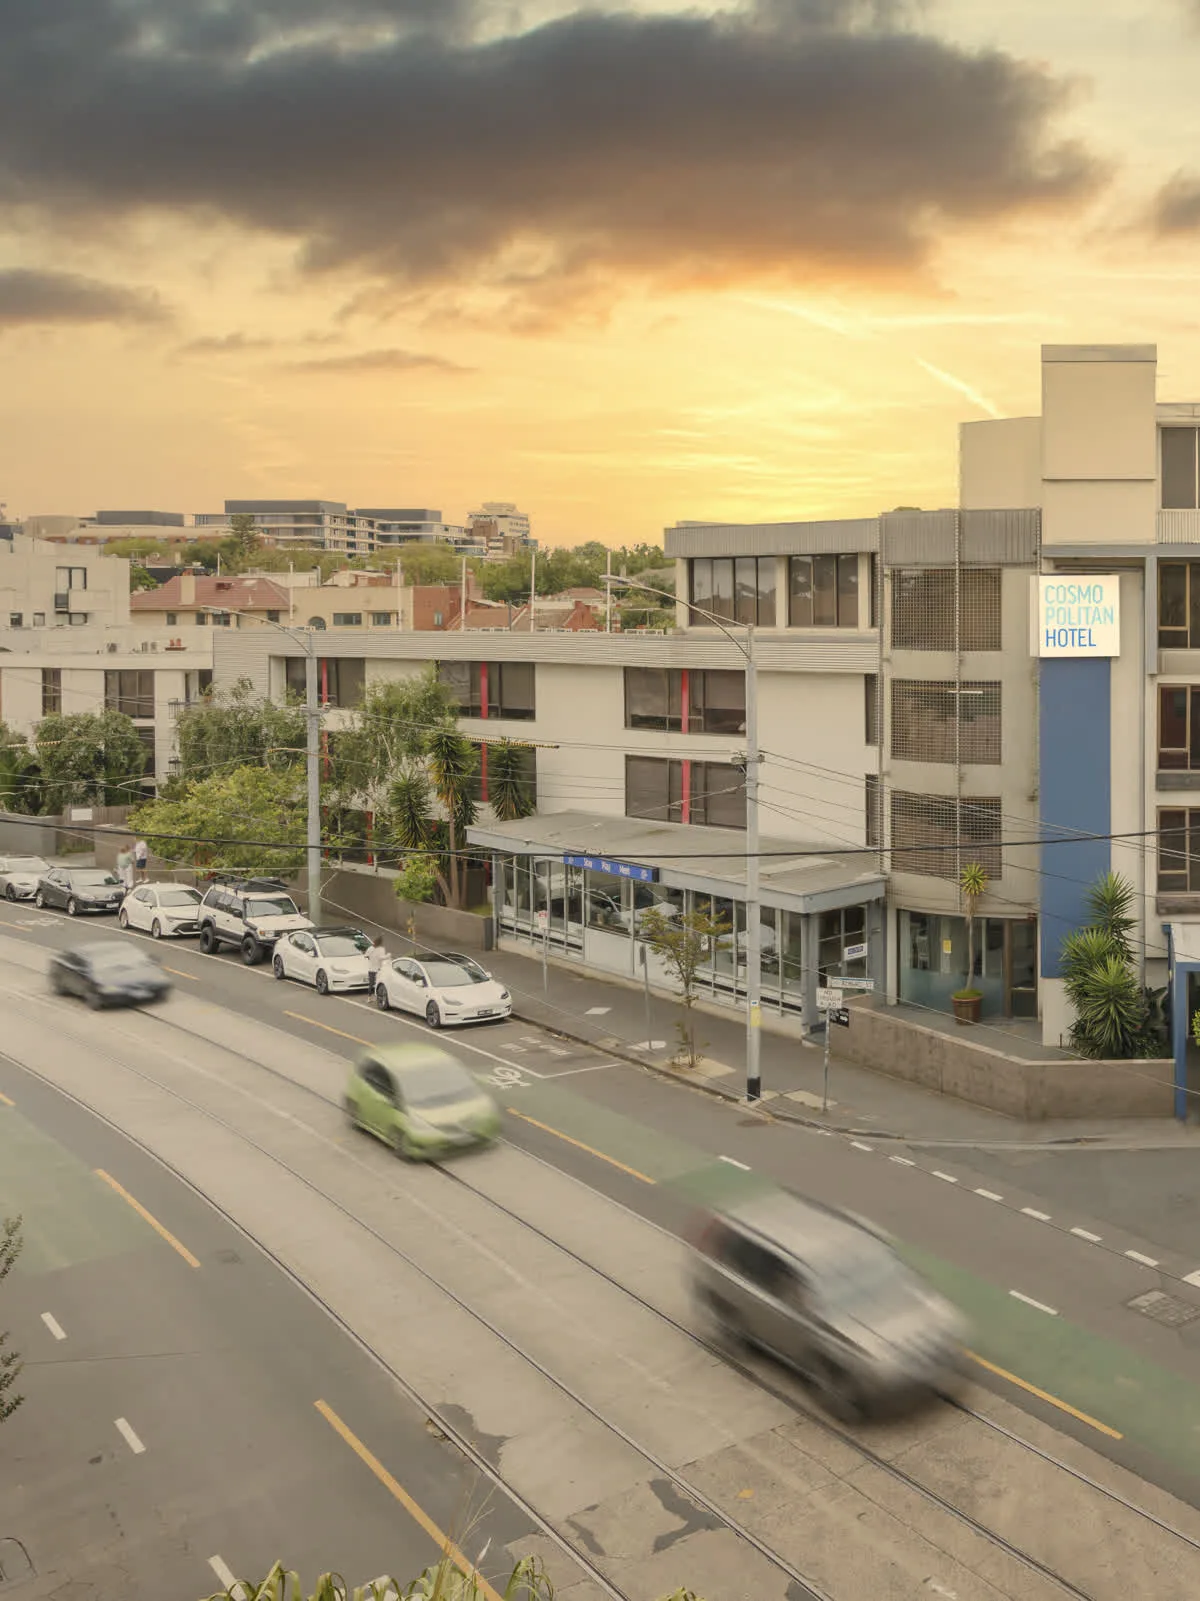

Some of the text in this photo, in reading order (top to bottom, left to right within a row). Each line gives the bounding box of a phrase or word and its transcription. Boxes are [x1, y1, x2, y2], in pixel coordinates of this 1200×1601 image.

[1045, 585, 1103, 604] COSMO
[1045, 606, 1114, 625] POLITAN
[1045, 628, 1096, 647] HOTEL
